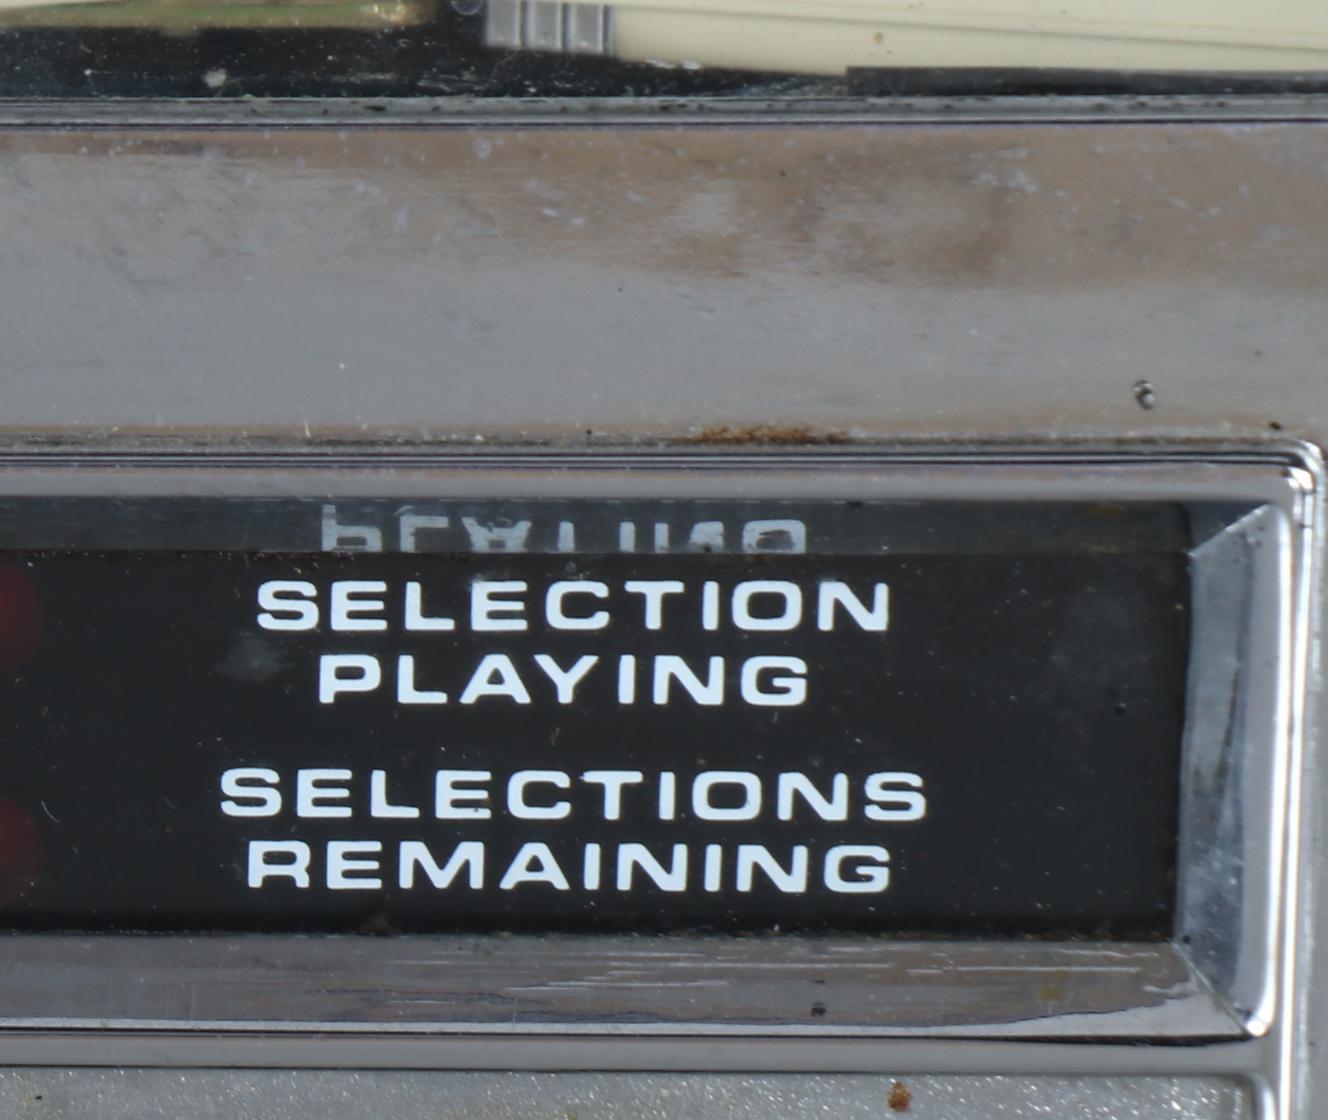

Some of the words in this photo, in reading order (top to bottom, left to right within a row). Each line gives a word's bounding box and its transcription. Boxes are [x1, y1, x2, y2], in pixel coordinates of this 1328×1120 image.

[258, 580, 888, 632] SELECTION
[320, 653, 808, 707] PLAYING
[220, 767, 927, 822] SELECTIONS
[247, 840, 890, 894] REMAINING
